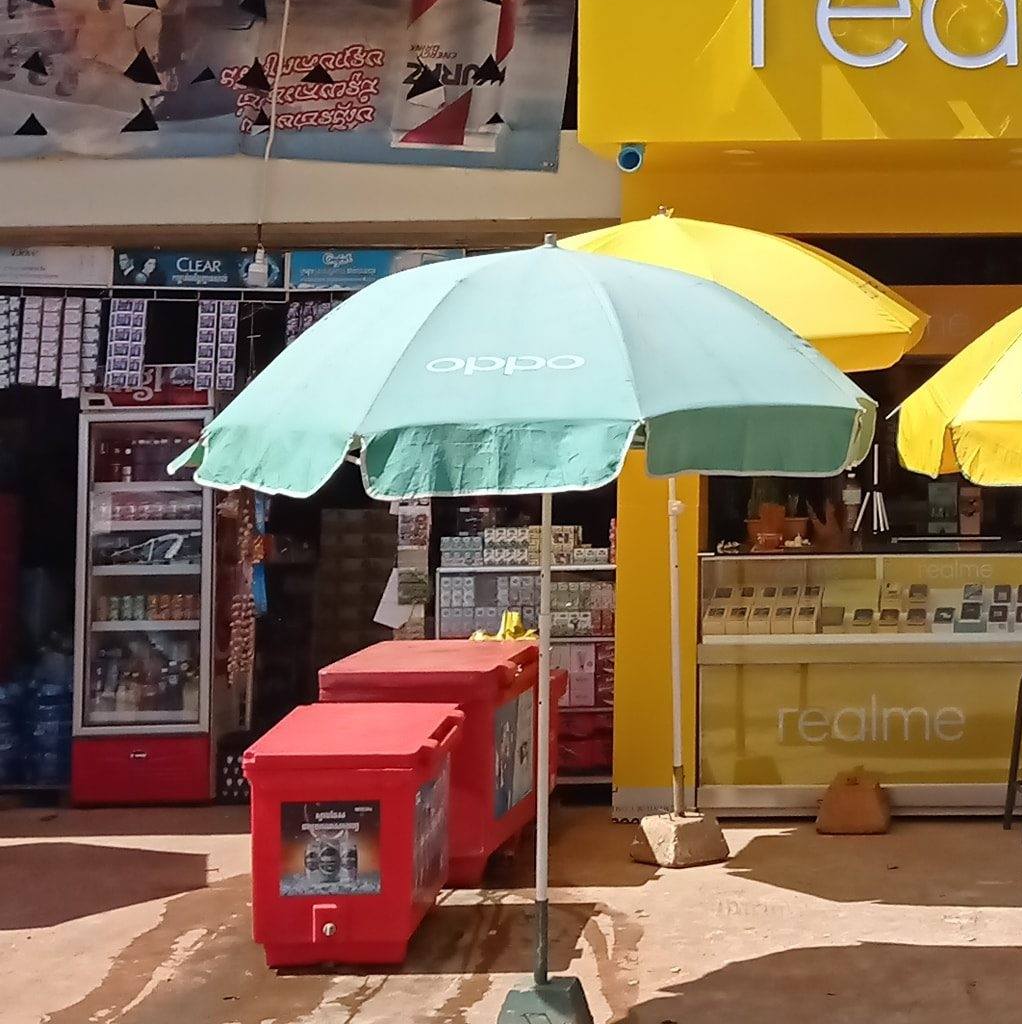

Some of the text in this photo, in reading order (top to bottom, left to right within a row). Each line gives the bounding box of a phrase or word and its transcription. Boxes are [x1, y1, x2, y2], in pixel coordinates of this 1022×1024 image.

[176, 257, 222, 273] CLEAR
[425, 354, 586, 376] oppo
[777, 693, 966, 744] realme
